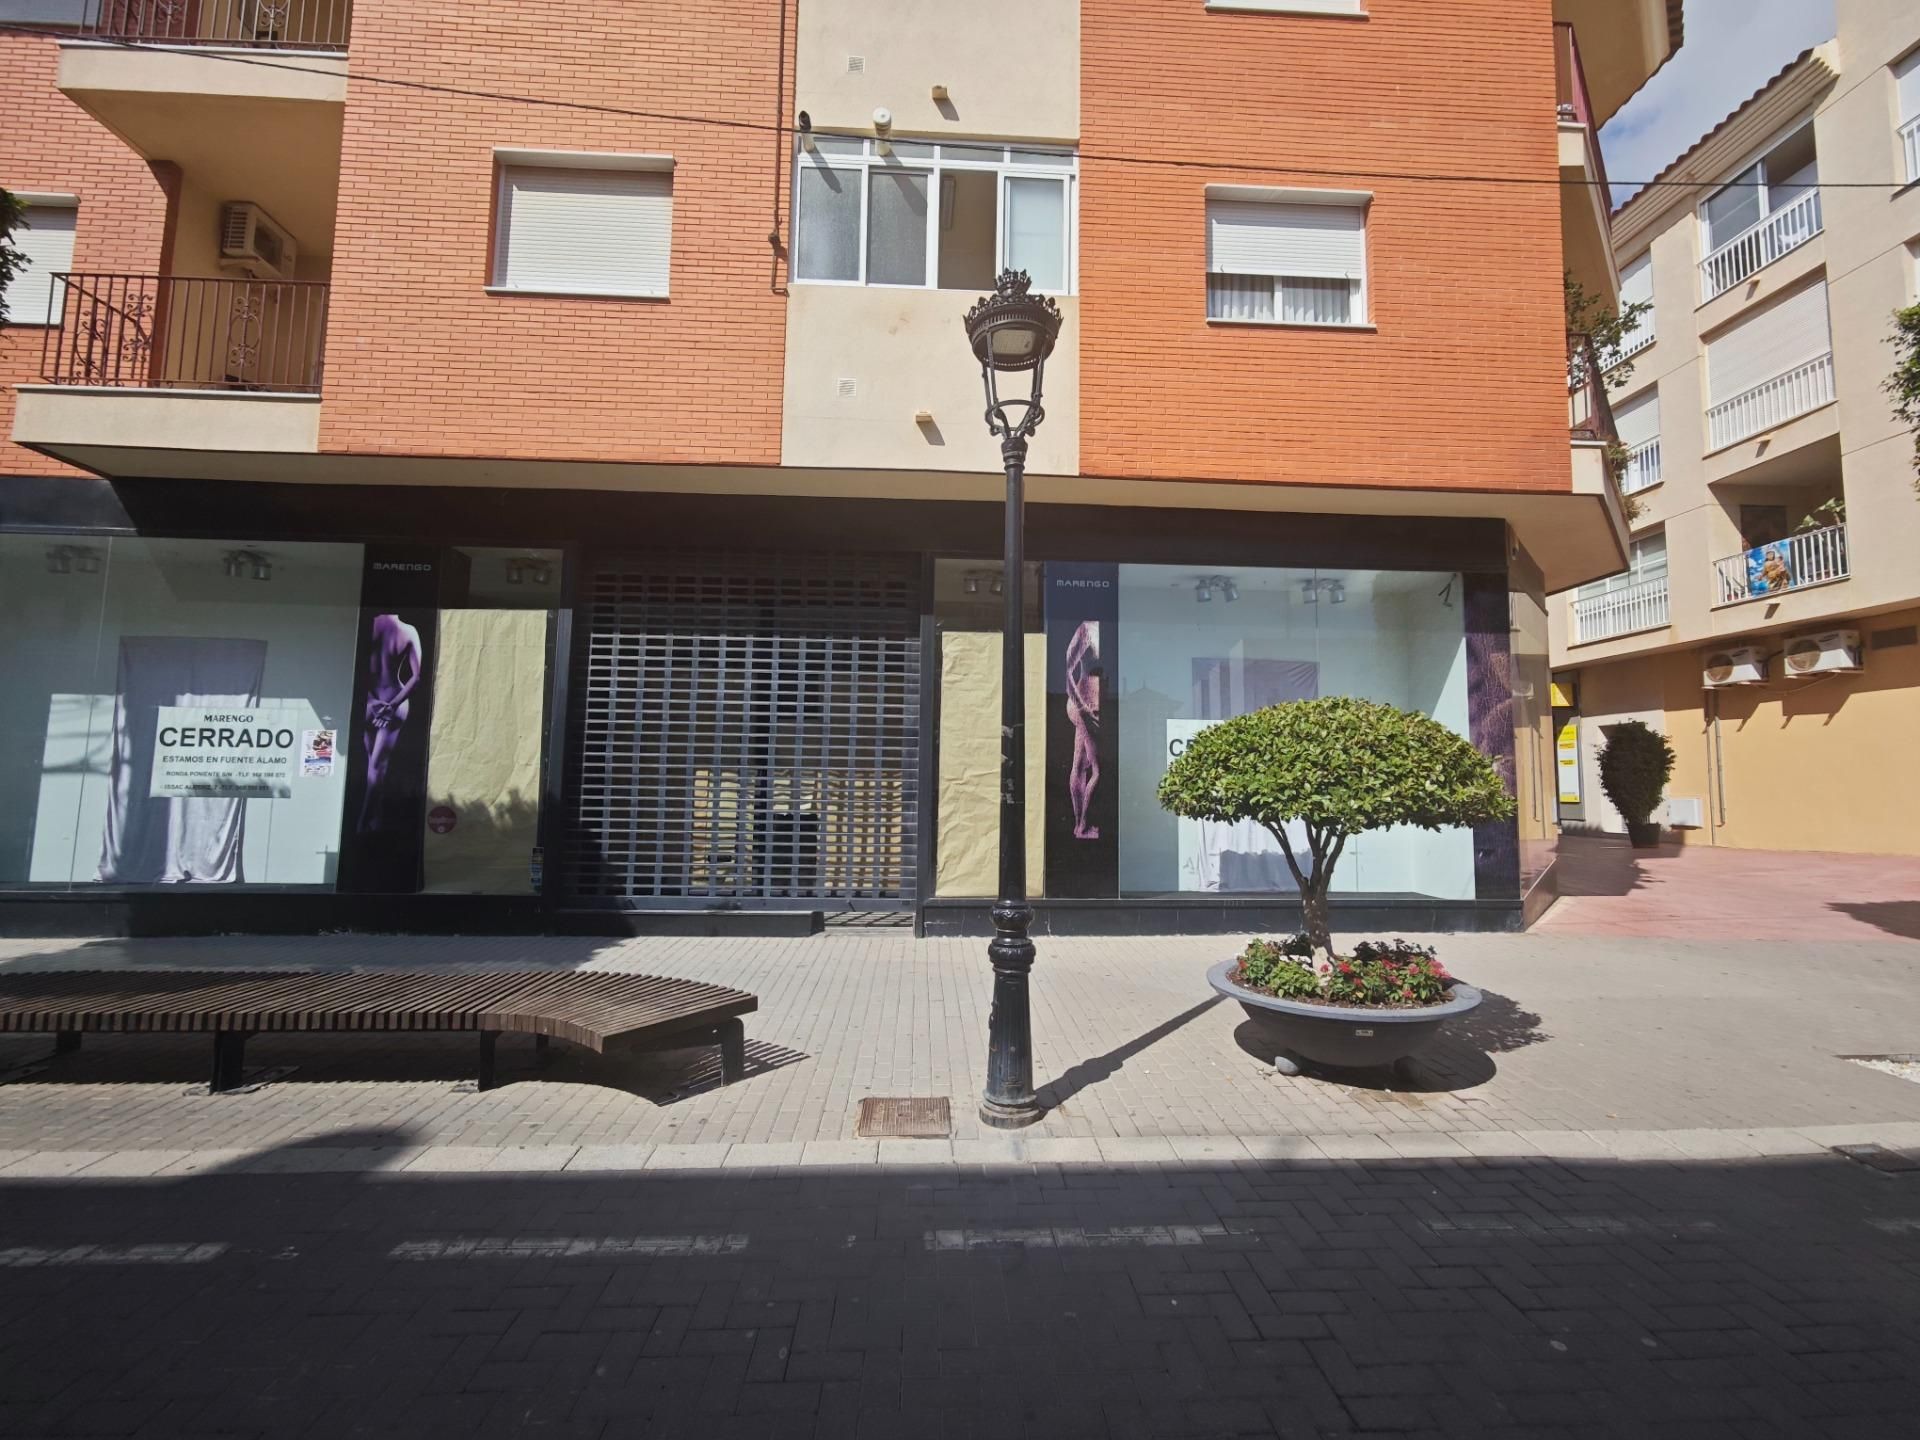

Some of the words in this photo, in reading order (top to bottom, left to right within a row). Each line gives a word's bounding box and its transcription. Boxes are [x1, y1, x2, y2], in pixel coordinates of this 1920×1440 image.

[373, 562, 432, 572] MARENGO
[1056, 579, 1110, 588] MARENGO
[203, 714, 254, 723] MARENGO
[159, 726, 294, 749] CERRADO
[162, 755, 204, 764] ESTAMOS
[206, 756, 219, 764] EN
[220, 756, 254, 764] FUENTE
[256, 755, 288, 765] ÁLAMO
